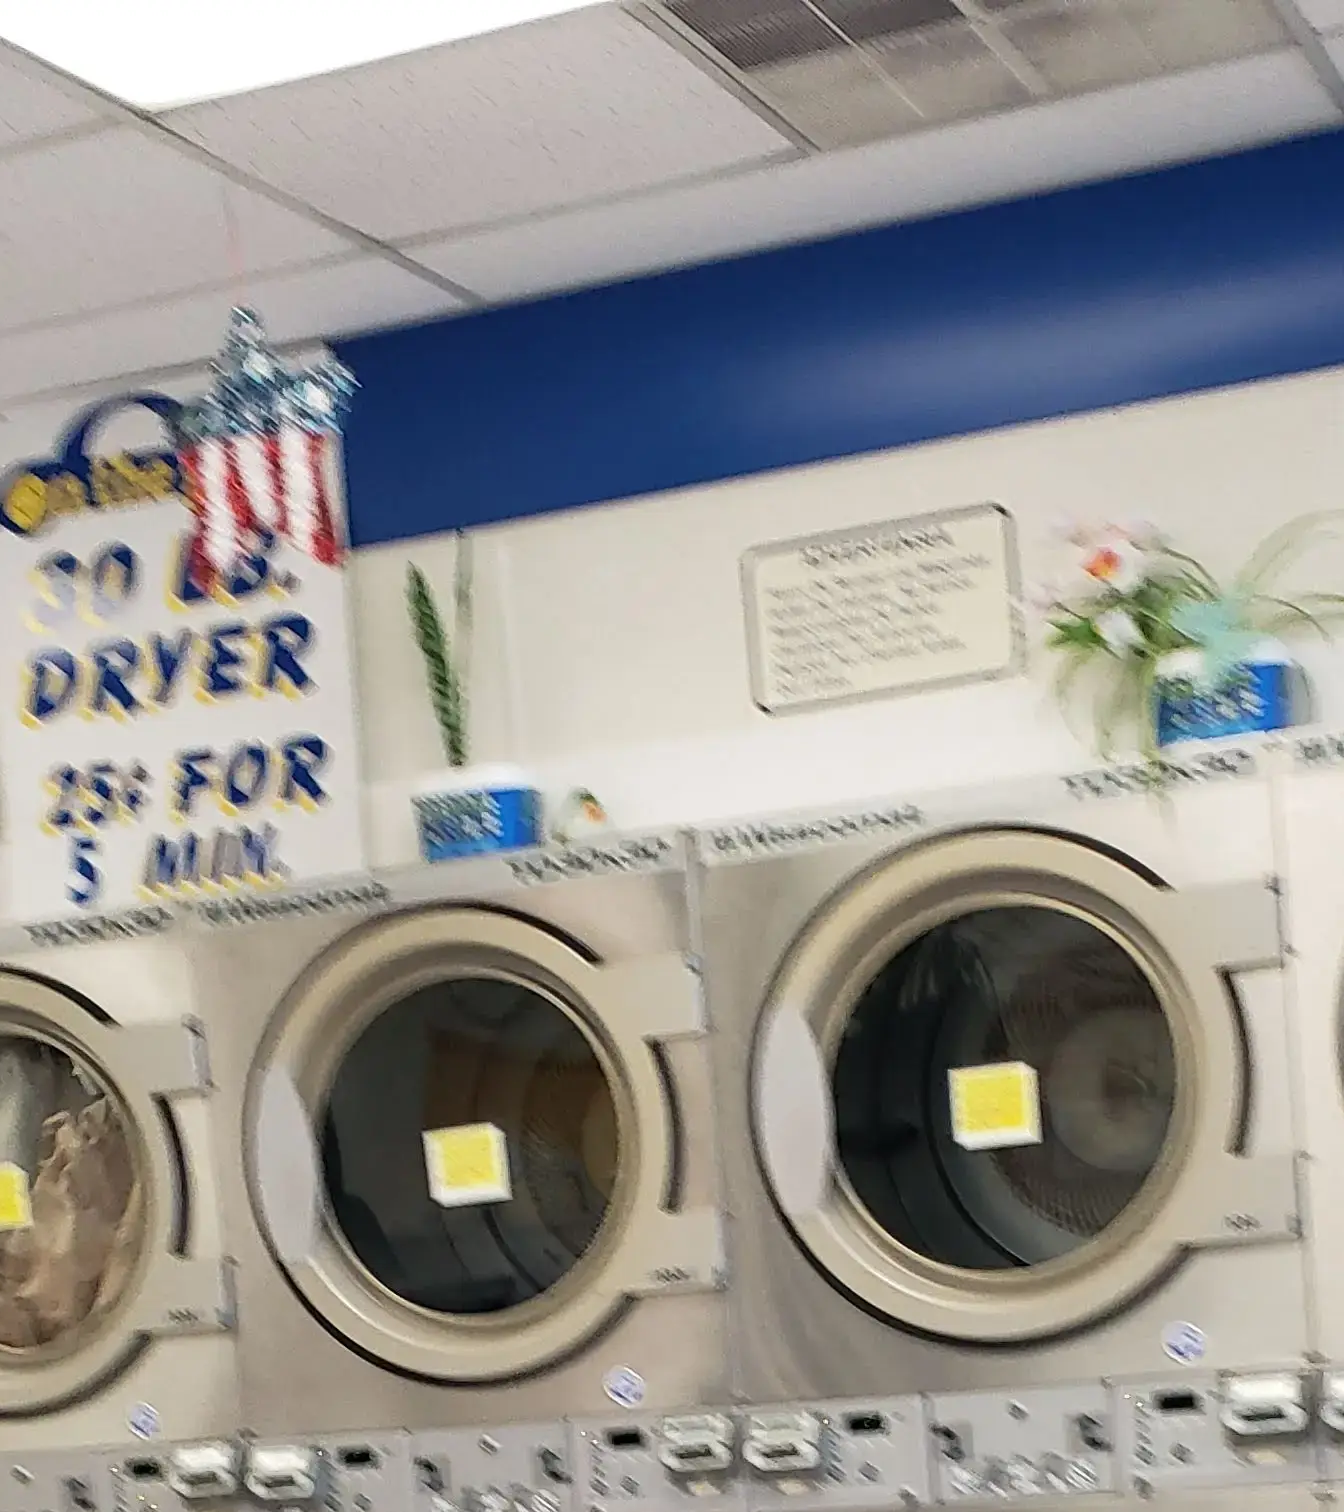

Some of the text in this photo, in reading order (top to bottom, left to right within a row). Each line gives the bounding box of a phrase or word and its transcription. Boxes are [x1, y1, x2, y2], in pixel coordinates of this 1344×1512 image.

[20, 611, 320, 729] DRYER
[169, 733, 333, 824] FOR
[66, 834, 102, 907] 5
